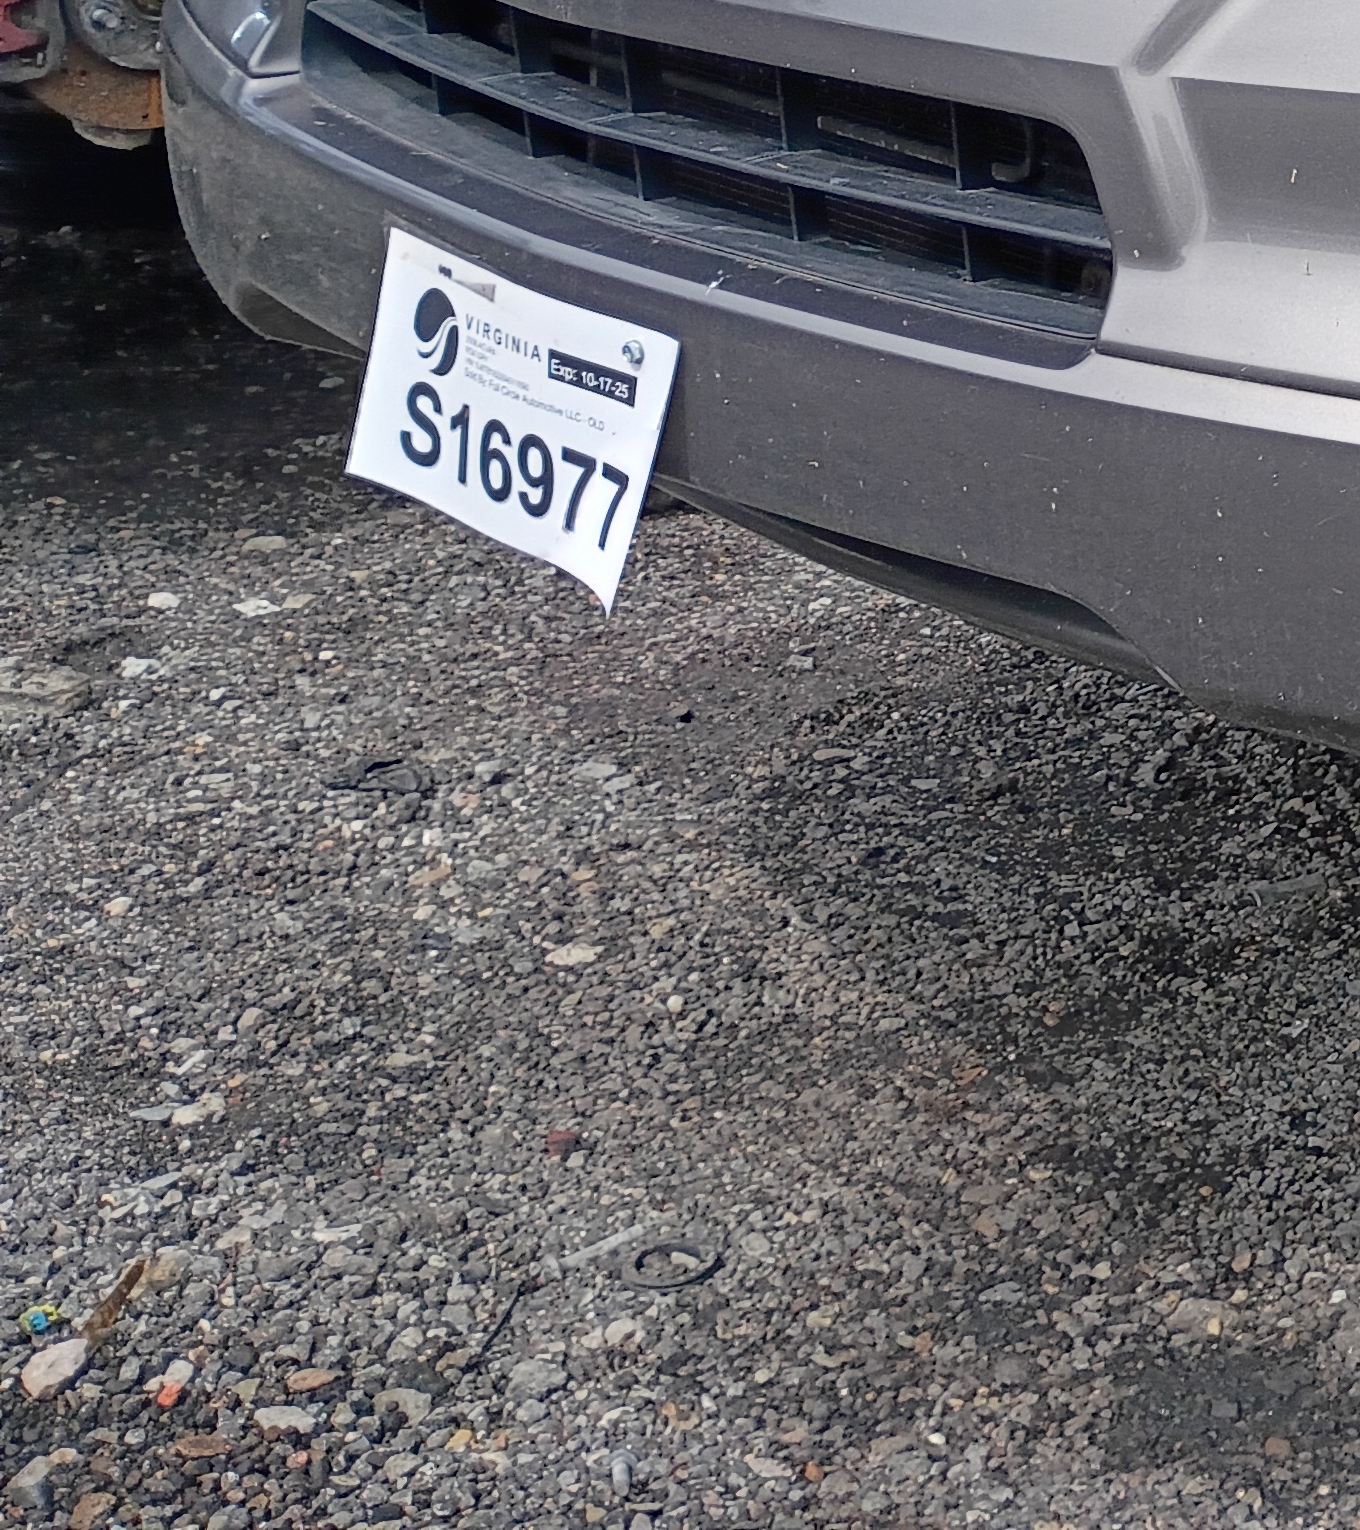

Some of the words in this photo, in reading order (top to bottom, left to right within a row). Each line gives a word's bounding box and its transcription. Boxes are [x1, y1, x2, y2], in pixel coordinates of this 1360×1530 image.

[465, 313, 542, 363] VIRGINIA
[550, 358, 579, 382] Exp:
[581, 371, 630, 399] 10-17-25
[399, 381, 630, 552] S16977
